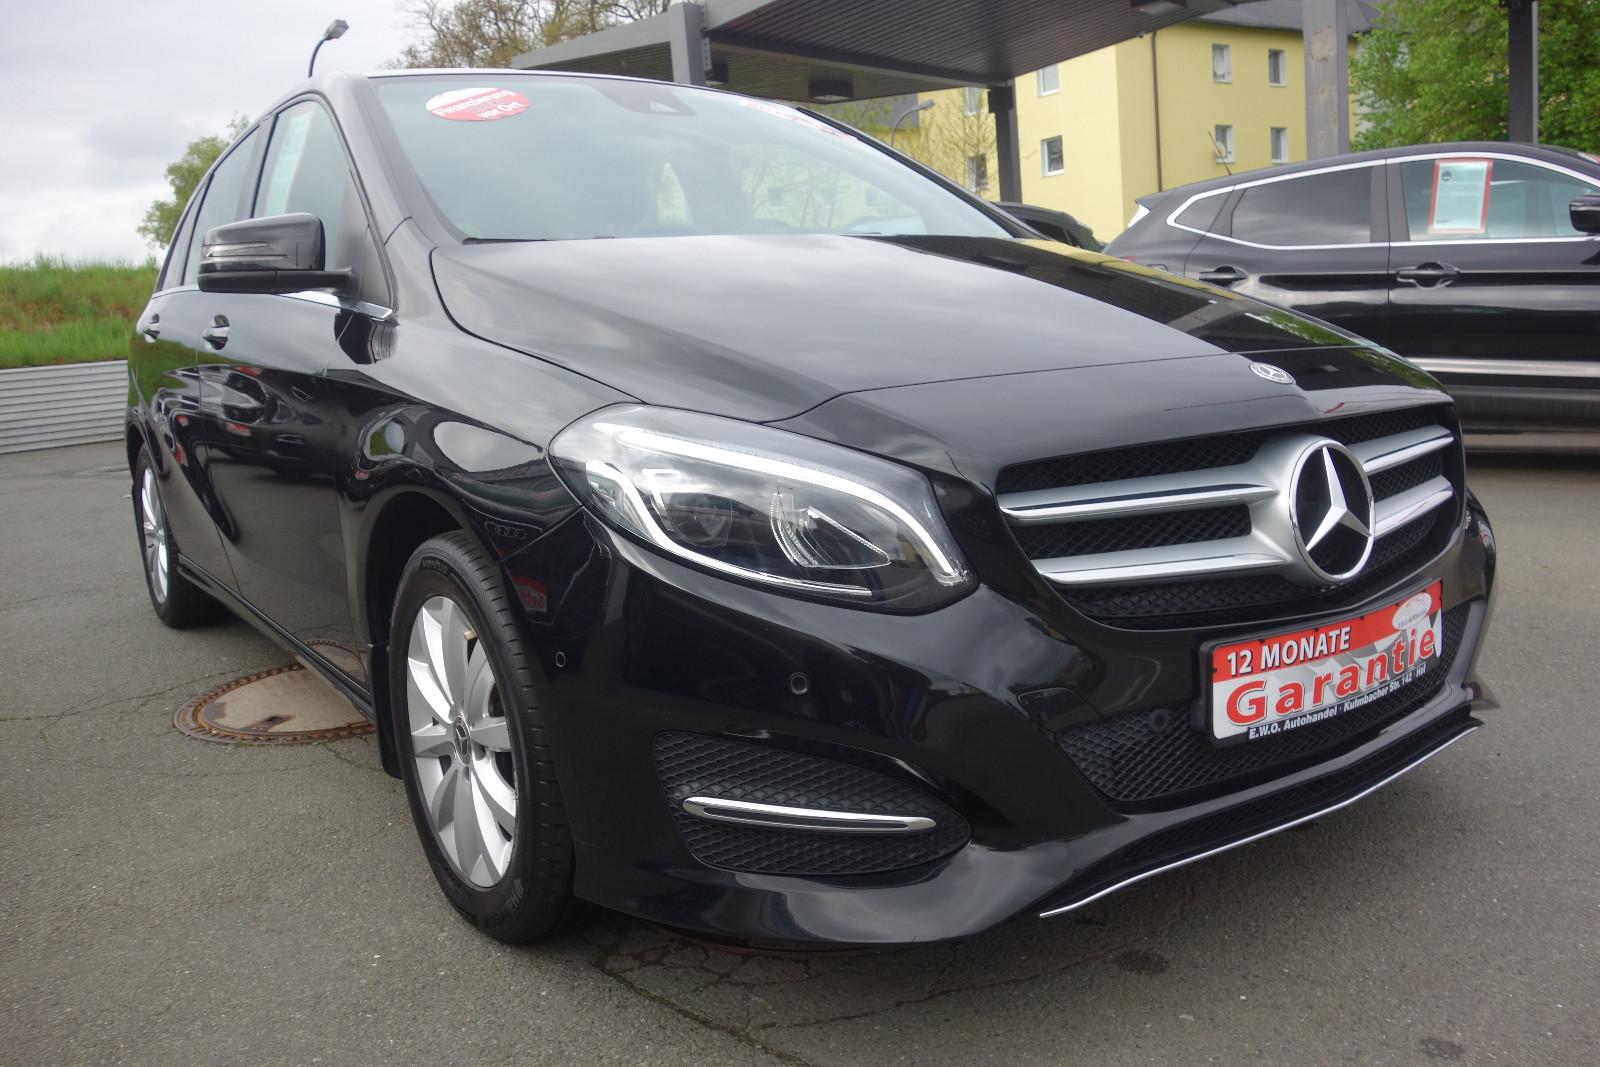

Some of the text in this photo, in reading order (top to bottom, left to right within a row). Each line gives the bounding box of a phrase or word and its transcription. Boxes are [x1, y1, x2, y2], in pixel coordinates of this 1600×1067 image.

[1226, 627, 1435, 726] Garantie
[1227, 626, 1351, 676] 12 MONATE
[1249, 723, 1281, 740] E.W.O.
[1283, 706, 1338, 732] Autohandel
[1343, 687, 1389, 711] Kulmbacher
[1389, 680, 1401, 693] Str.
[1402, 672, 1413, 687] 142
